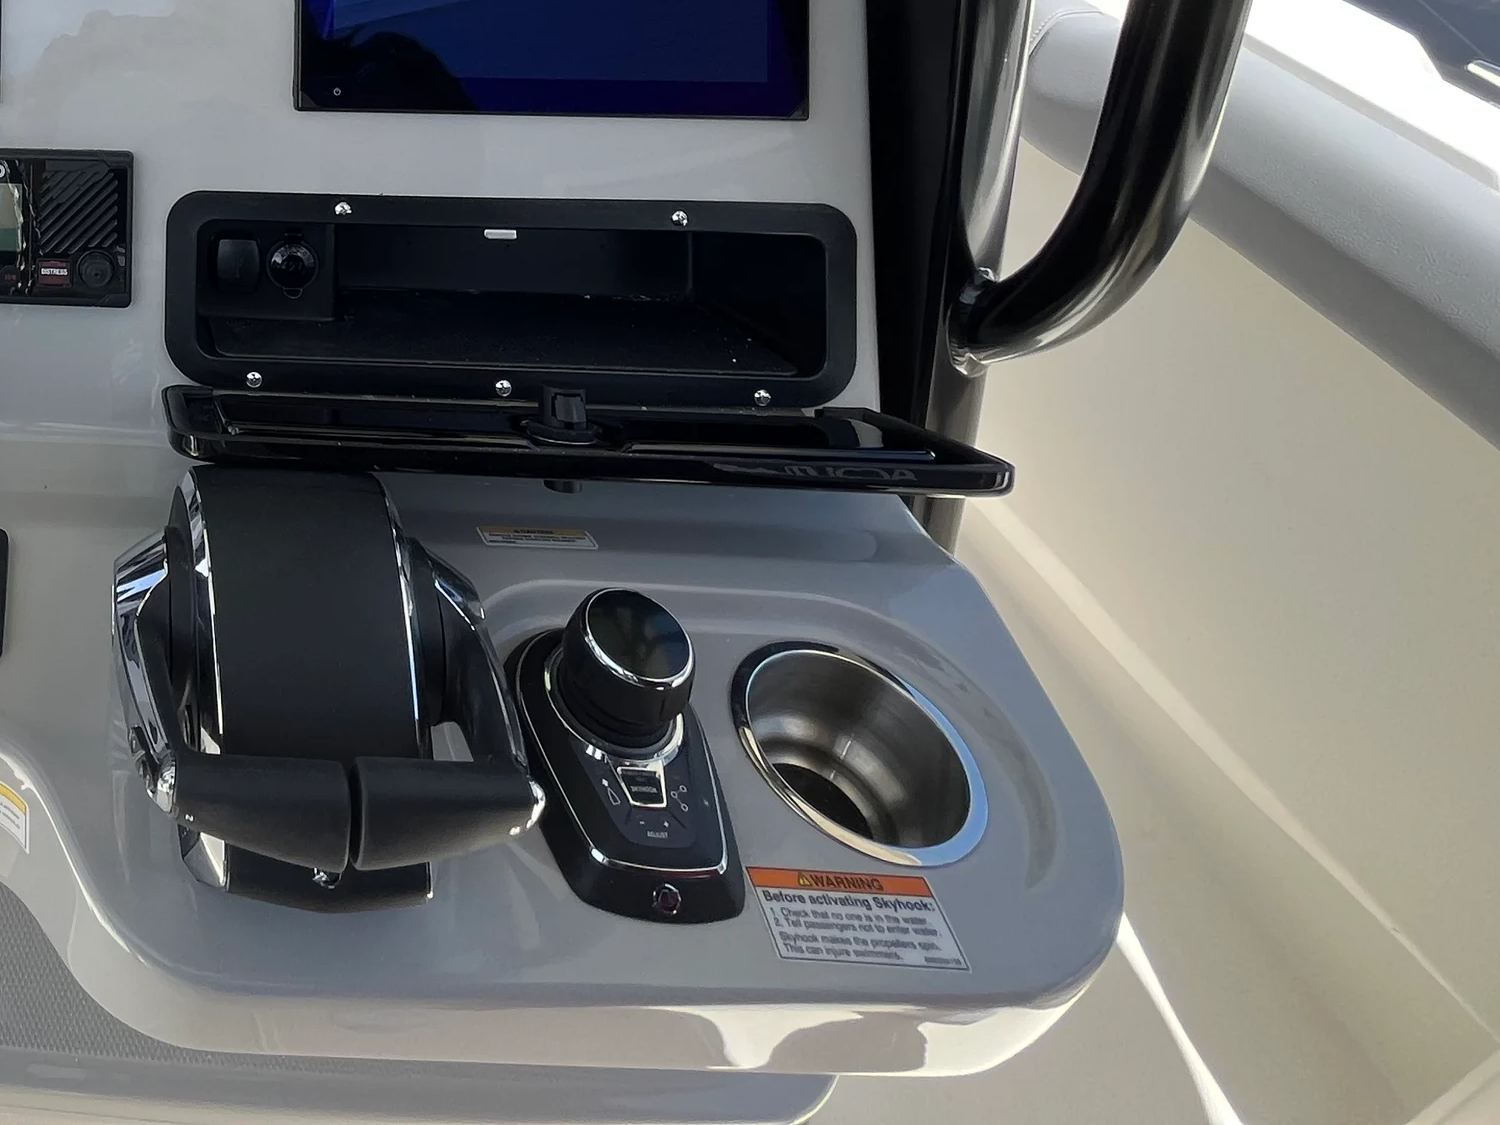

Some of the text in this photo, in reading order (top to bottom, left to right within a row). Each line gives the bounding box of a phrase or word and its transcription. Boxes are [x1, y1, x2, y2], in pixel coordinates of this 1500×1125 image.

[41, 268, 68, 276] DISTRESS
[810, 874, 884, 892] WARNING
[762, 890, 936, 912] Before activating Skyhook:
[781, 908, 811, 919] Check
